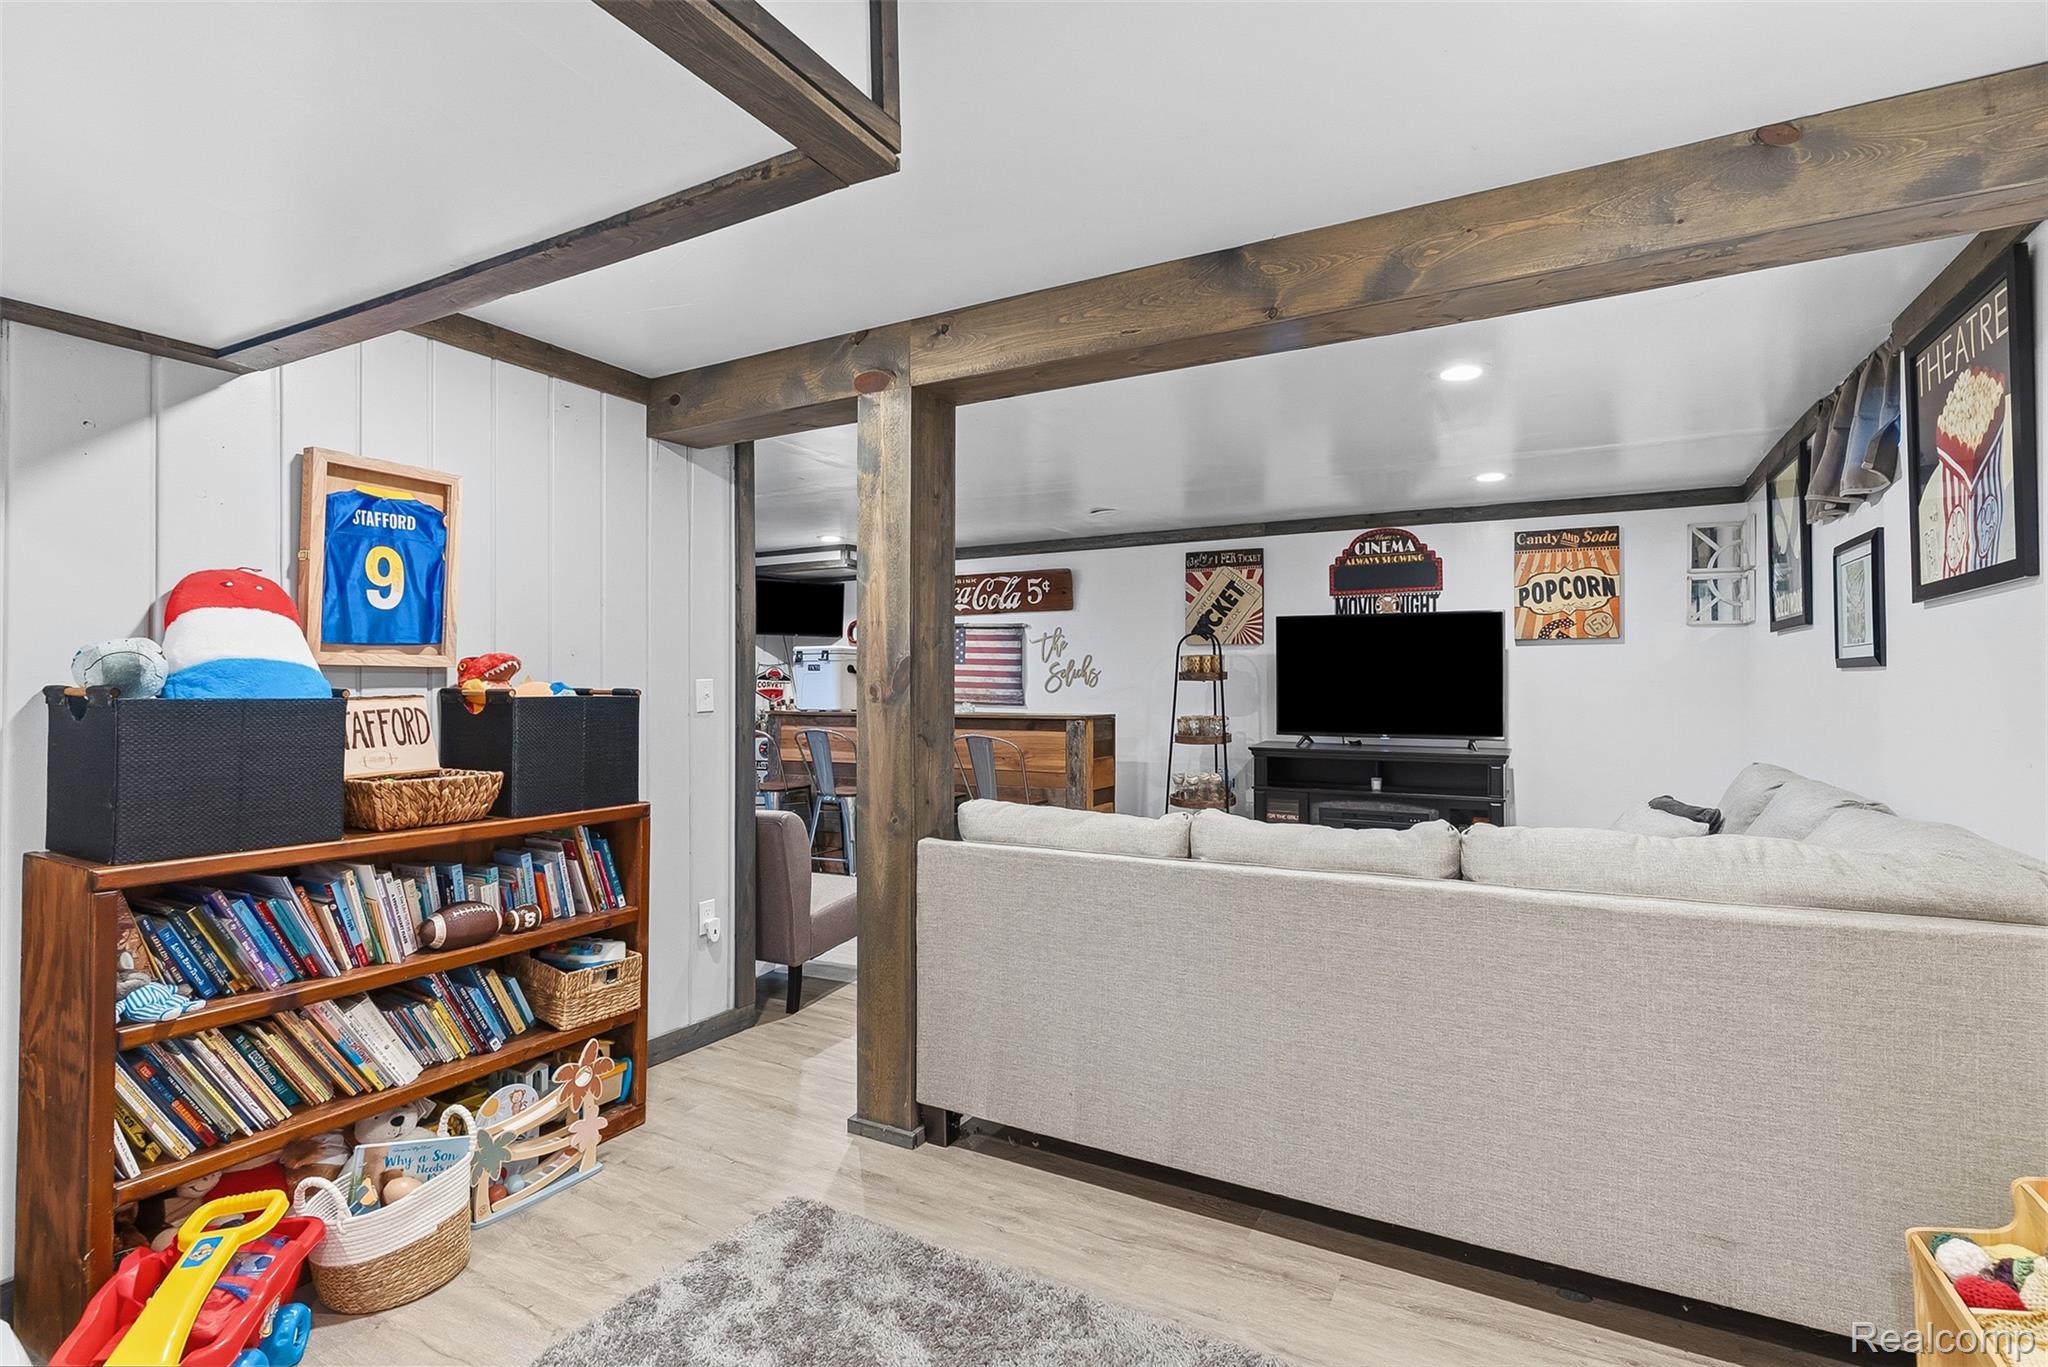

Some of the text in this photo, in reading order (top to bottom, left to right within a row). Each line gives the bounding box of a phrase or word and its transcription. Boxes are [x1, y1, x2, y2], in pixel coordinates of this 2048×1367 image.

[1916, 286, 2009, 398] THEATRE
[352, 509, 417, 531] STAFFORD
[1354, 539, 1416, 556] CINEMA
[1516, 530, 1618, 546] Candy AND Soda
[1345, 553, 1425, 566] ALWAYS SHOWING
[365, 545, 405, 610] 9
[1027, 577, 1051, 605] 5¢
[1518, 575, 1617, 607] POPCORN
[384, 1155, 412, 1169] Why
[418, 1154, 427, 1163] a
[432, 1149, 459, 1162] Son
[416, 1162, 444, 1174] Needs
